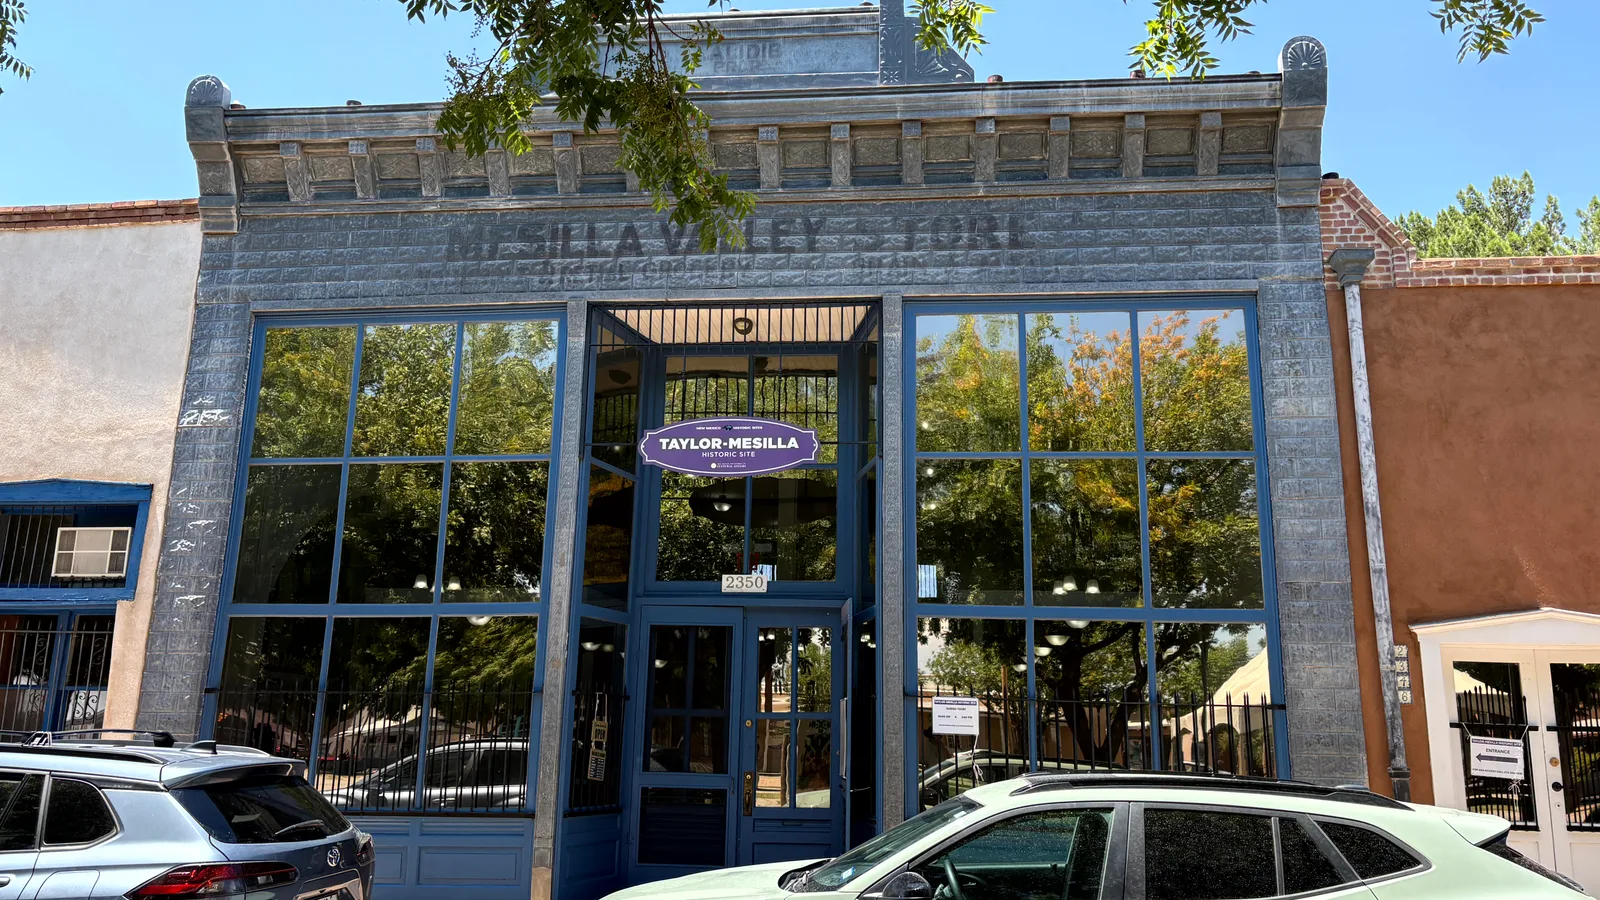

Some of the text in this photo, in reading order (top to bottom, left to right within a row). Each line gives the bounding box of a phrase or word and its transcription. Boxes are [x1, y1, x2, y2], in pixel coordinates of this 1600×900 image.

[659, 217, 827, 257] VALEY
[659, 437, 799, 450] TAYLOR-MESILLA
[726, 576, 764, 589] 2350
